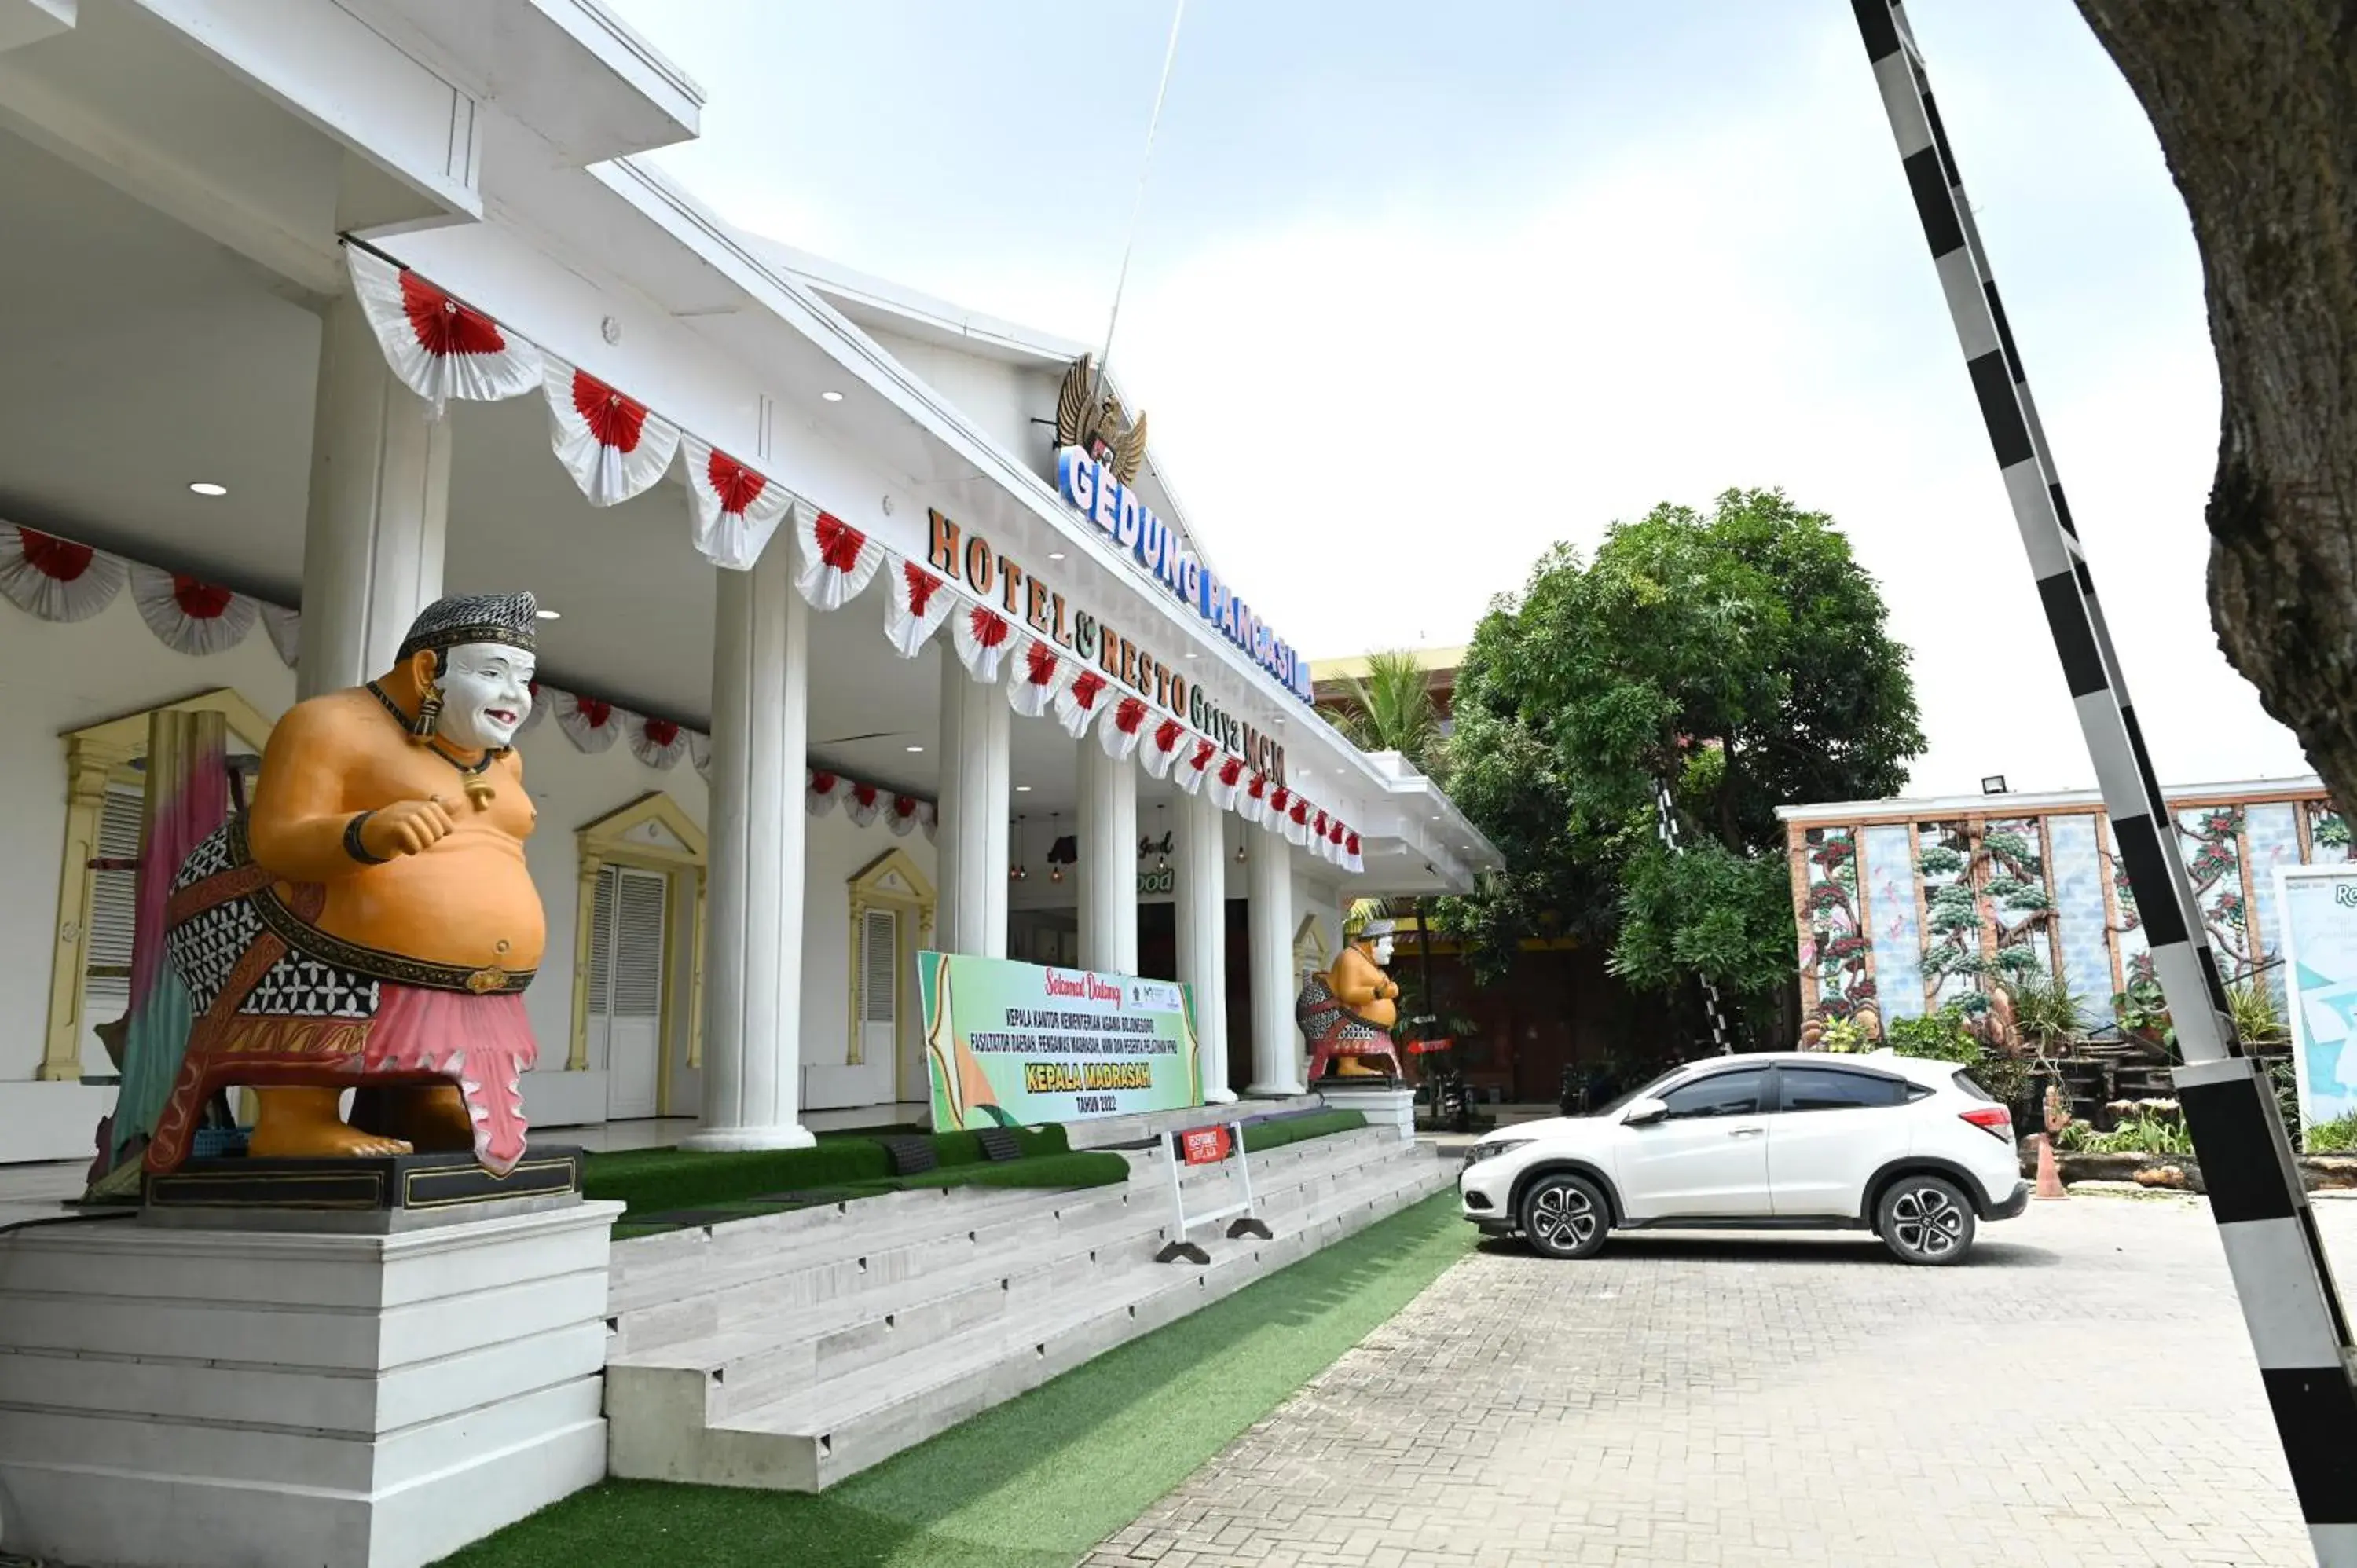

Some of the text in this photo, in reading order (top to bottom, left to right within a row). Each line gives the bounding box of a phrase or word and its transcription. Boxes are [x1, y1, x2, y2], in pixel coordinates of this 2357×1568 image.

[1058, 445, 1201, 606] GEDUNG
[929, 507, 1072, 649] HOTEL
[1075, 610, 1097, 660] &
[1099, 624, 1187, 718] RESTO
[1190, 684, 1241, 753] Griya
[1137, 868, 1175, 895] ood
[1045, 967, 1122, 1011] Selamat Datang
[1006, 1008, 1033, 1028] KEPALA
[1033, 1010, 1059, 1029] KANTOR
[970, 1032, 1010, 1052] FASILITATOR
[1025, 1061, 1152, 1094] KEPALA MADRASAH
[1076, 1095, 1116, 1113] TAHUN 2022
